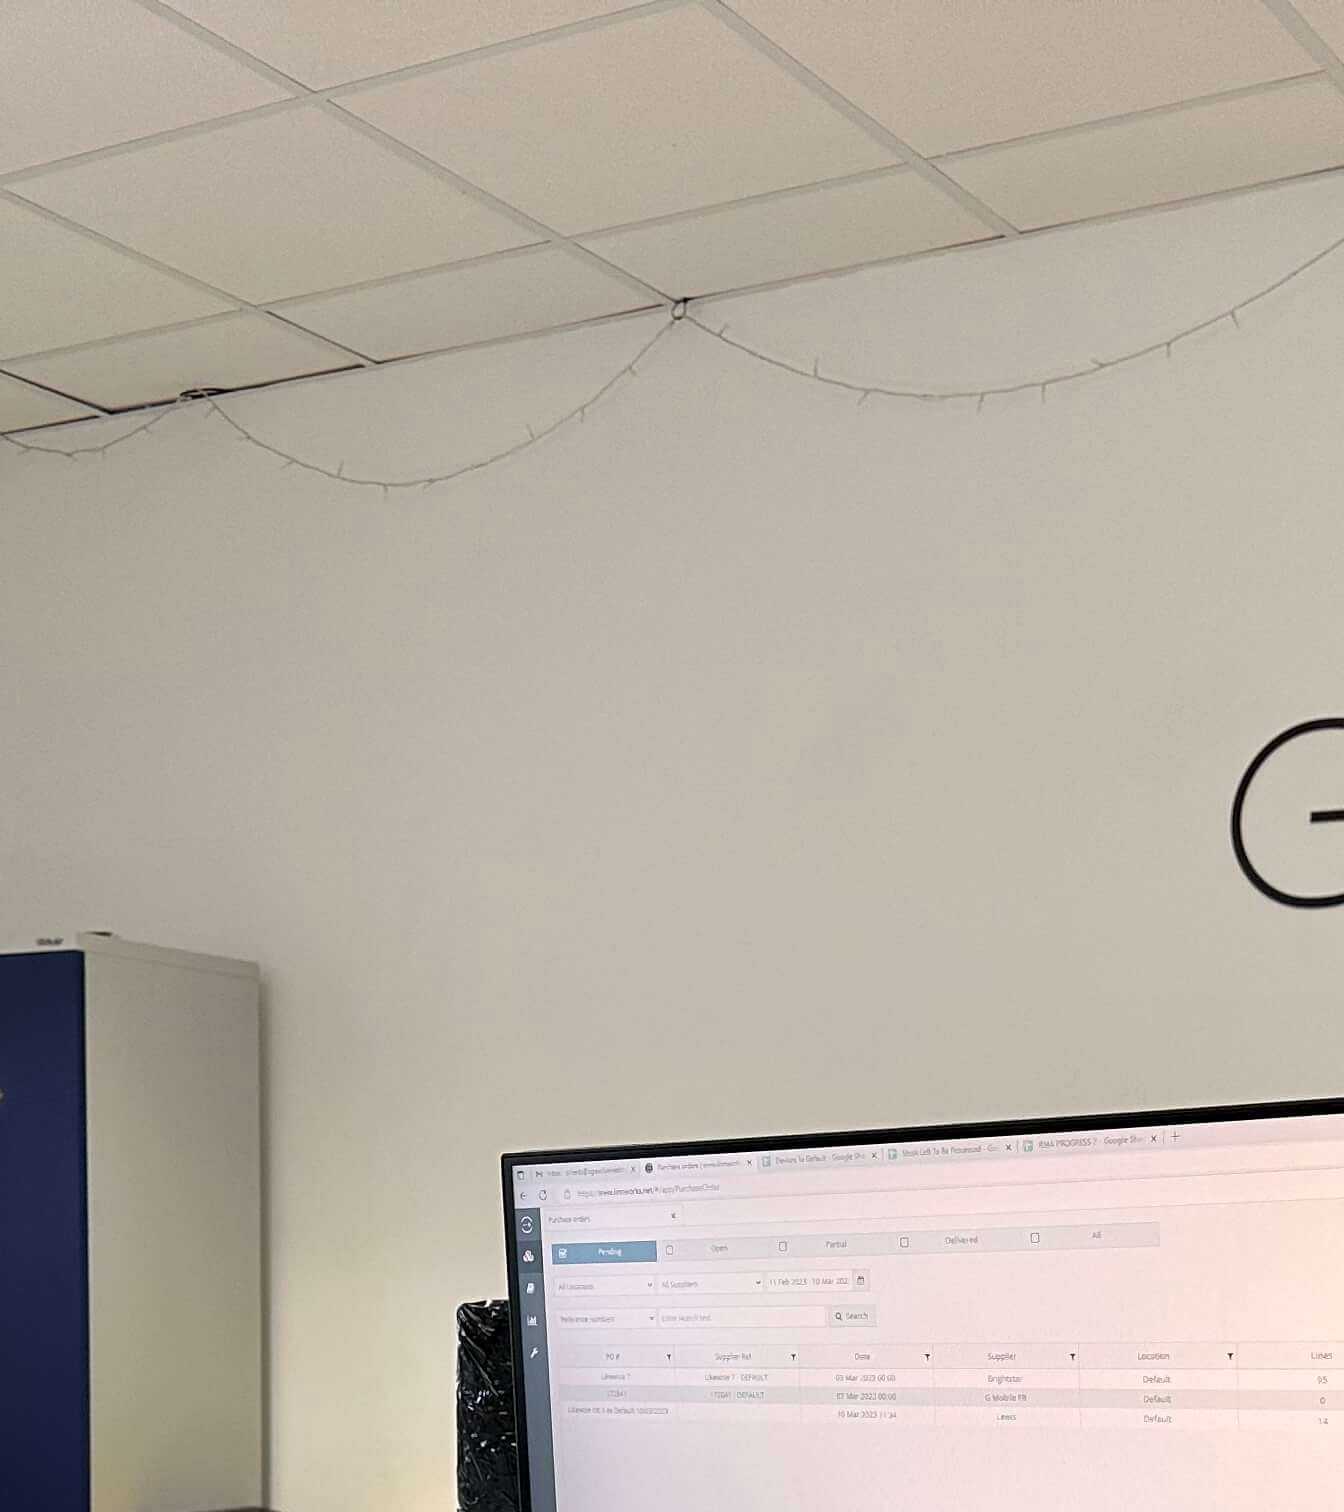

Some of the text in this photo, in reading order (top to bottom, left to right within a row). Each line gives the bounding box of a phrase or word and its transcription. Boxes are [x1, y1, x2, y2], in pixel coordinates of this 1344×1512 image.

[1104, 1136, 1128, 1146] Google
[826, 1239, 847, 1249] Partial
[945, 1235, 979, 1246] Delivered
[598, 1248, 622, 1258] Pending
[846, 1311, 868, 1322] Search
[988, 1352, 1016, 1362] Supplier
[1138, 1352, 1170, 1361] Location
[1311, 1351, 1332, 1360] Lines
[1143, 1375, 1170, 1383] Default
[1143, 1395, 1172, 1403] Default
[1144, 1415, 1172, 1424] Default
